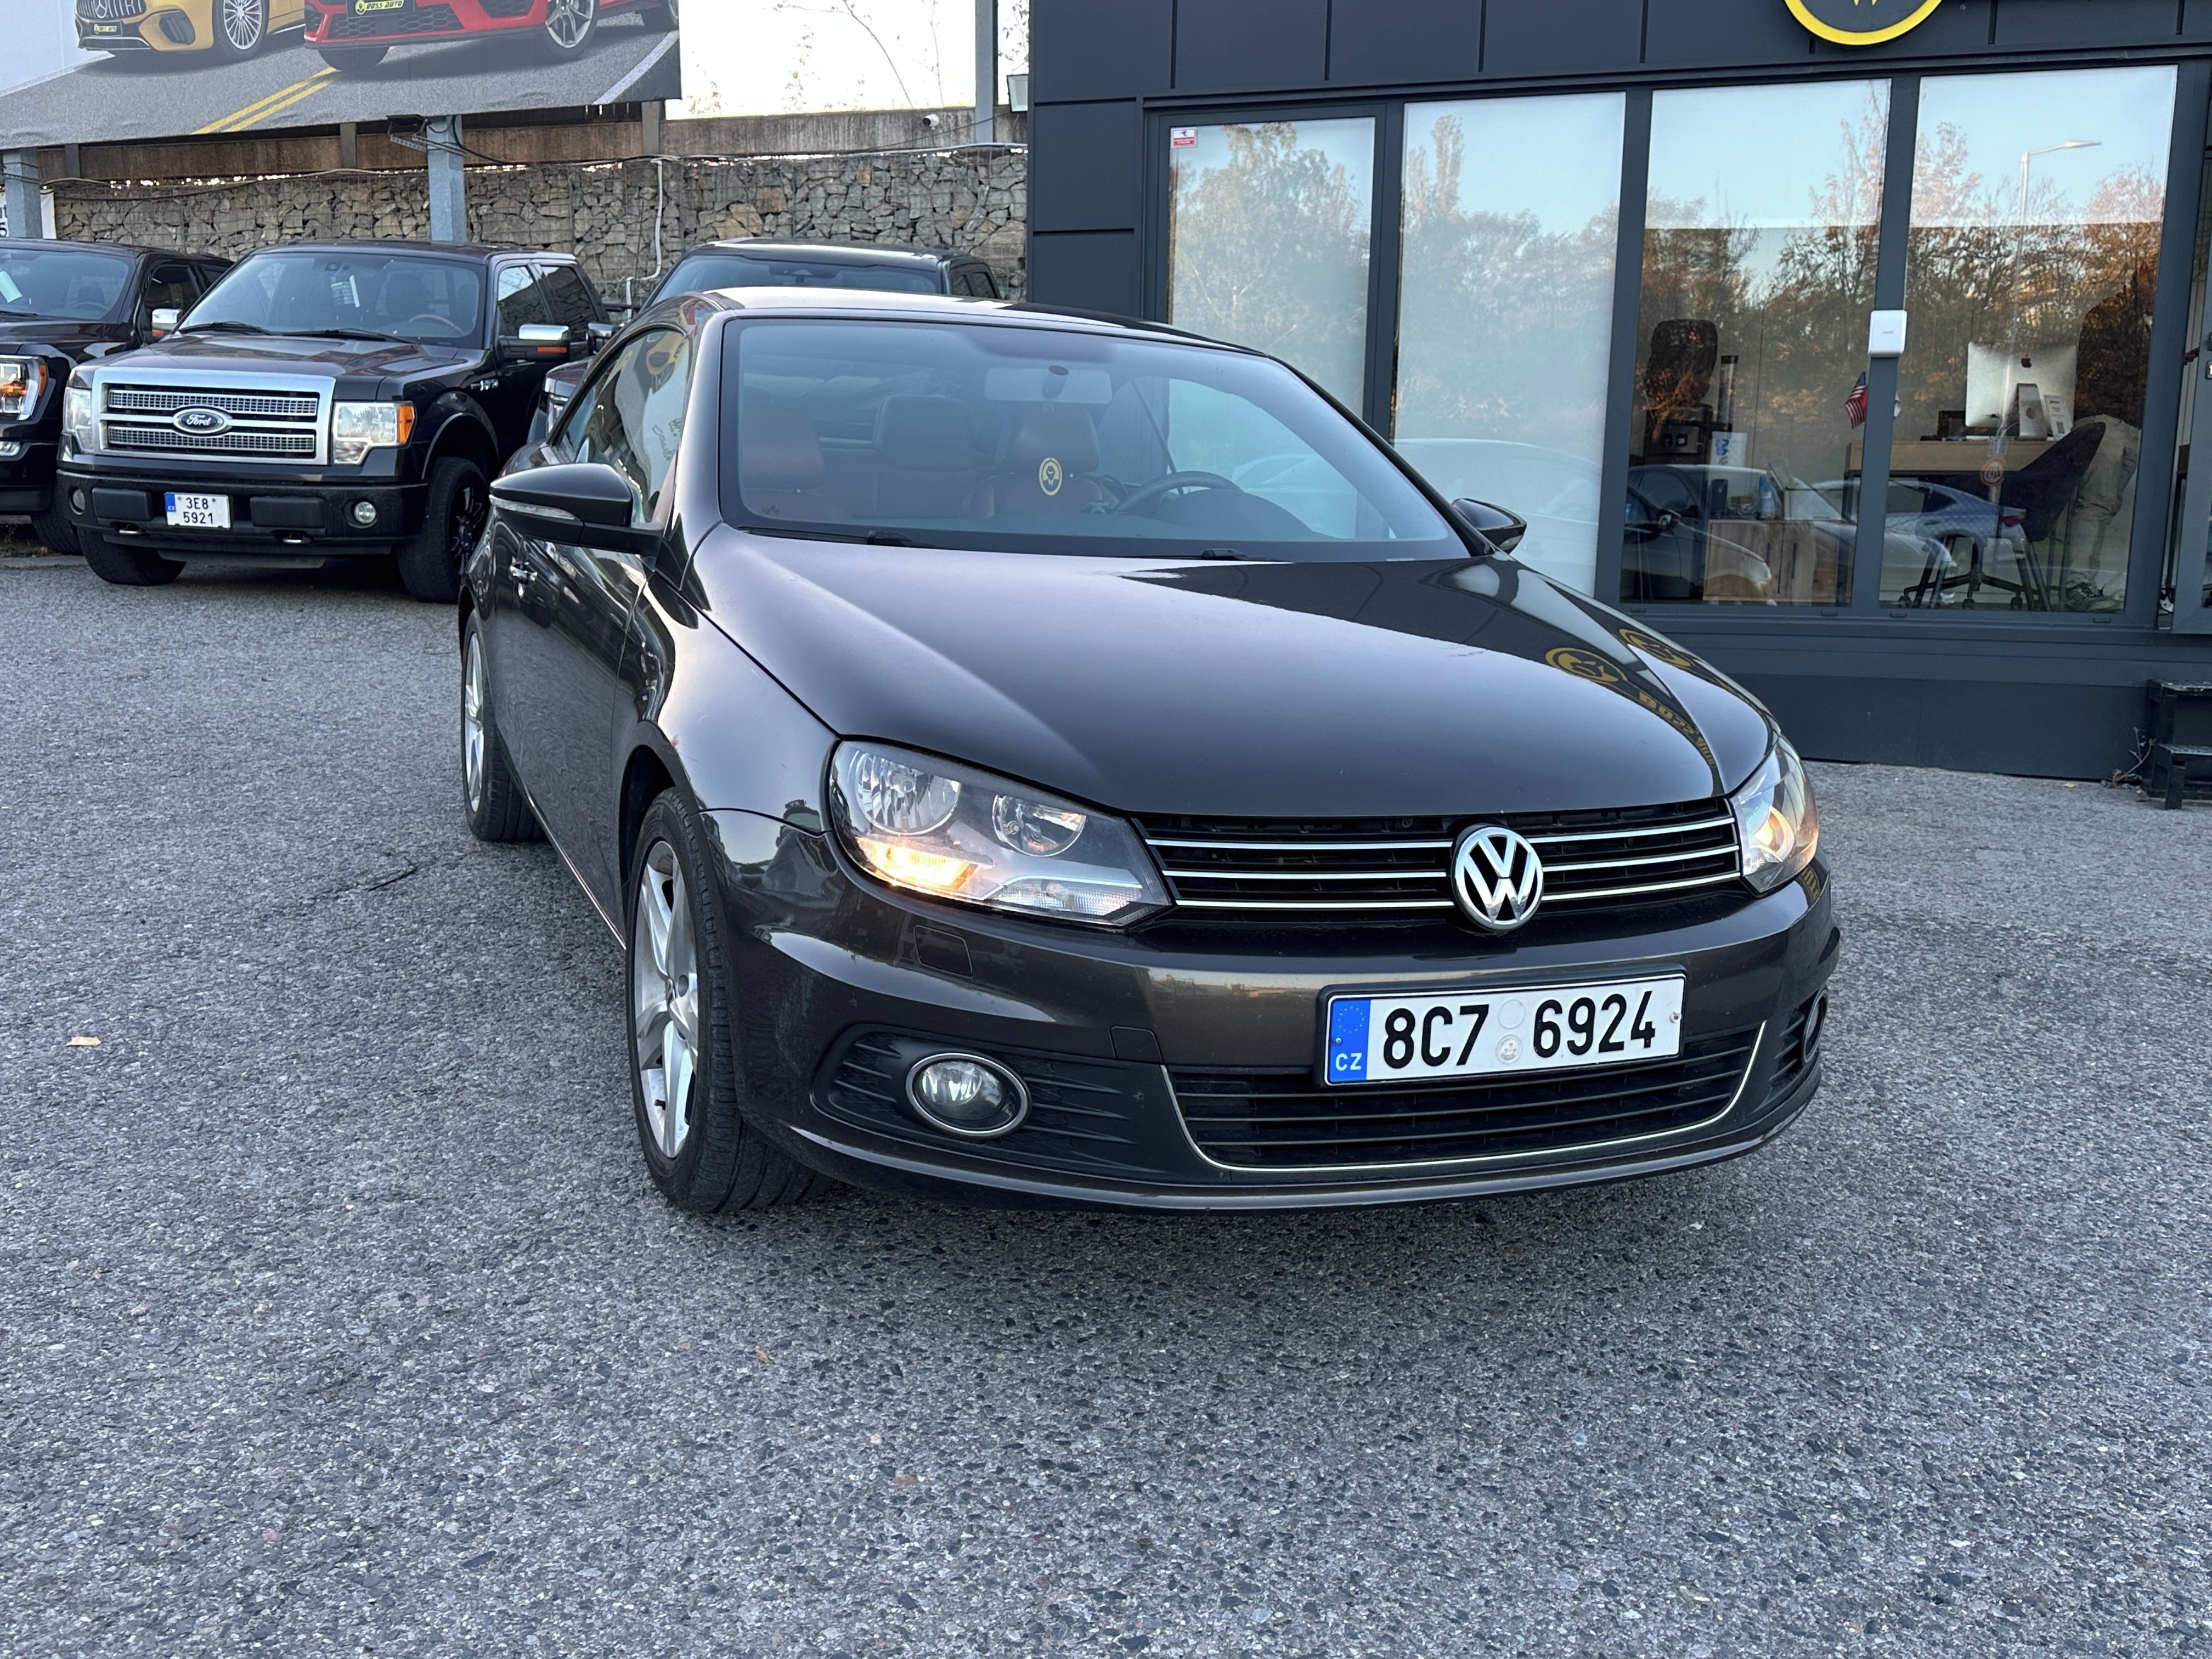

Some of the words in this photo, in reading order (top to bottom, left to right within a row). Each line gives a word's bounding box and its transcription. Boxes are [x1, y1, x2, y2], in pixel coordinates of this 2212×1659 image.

[187, 414, 211, 426] Ford
[185, 497, 209, 510] 3E8
[183, 511, 213, 524] 5921
[1384, 1004, 1489, 1069] 8C7
[1533, 990, 1656, 1058] 6924
[1335, 1052, 1362, 1071] CZ
